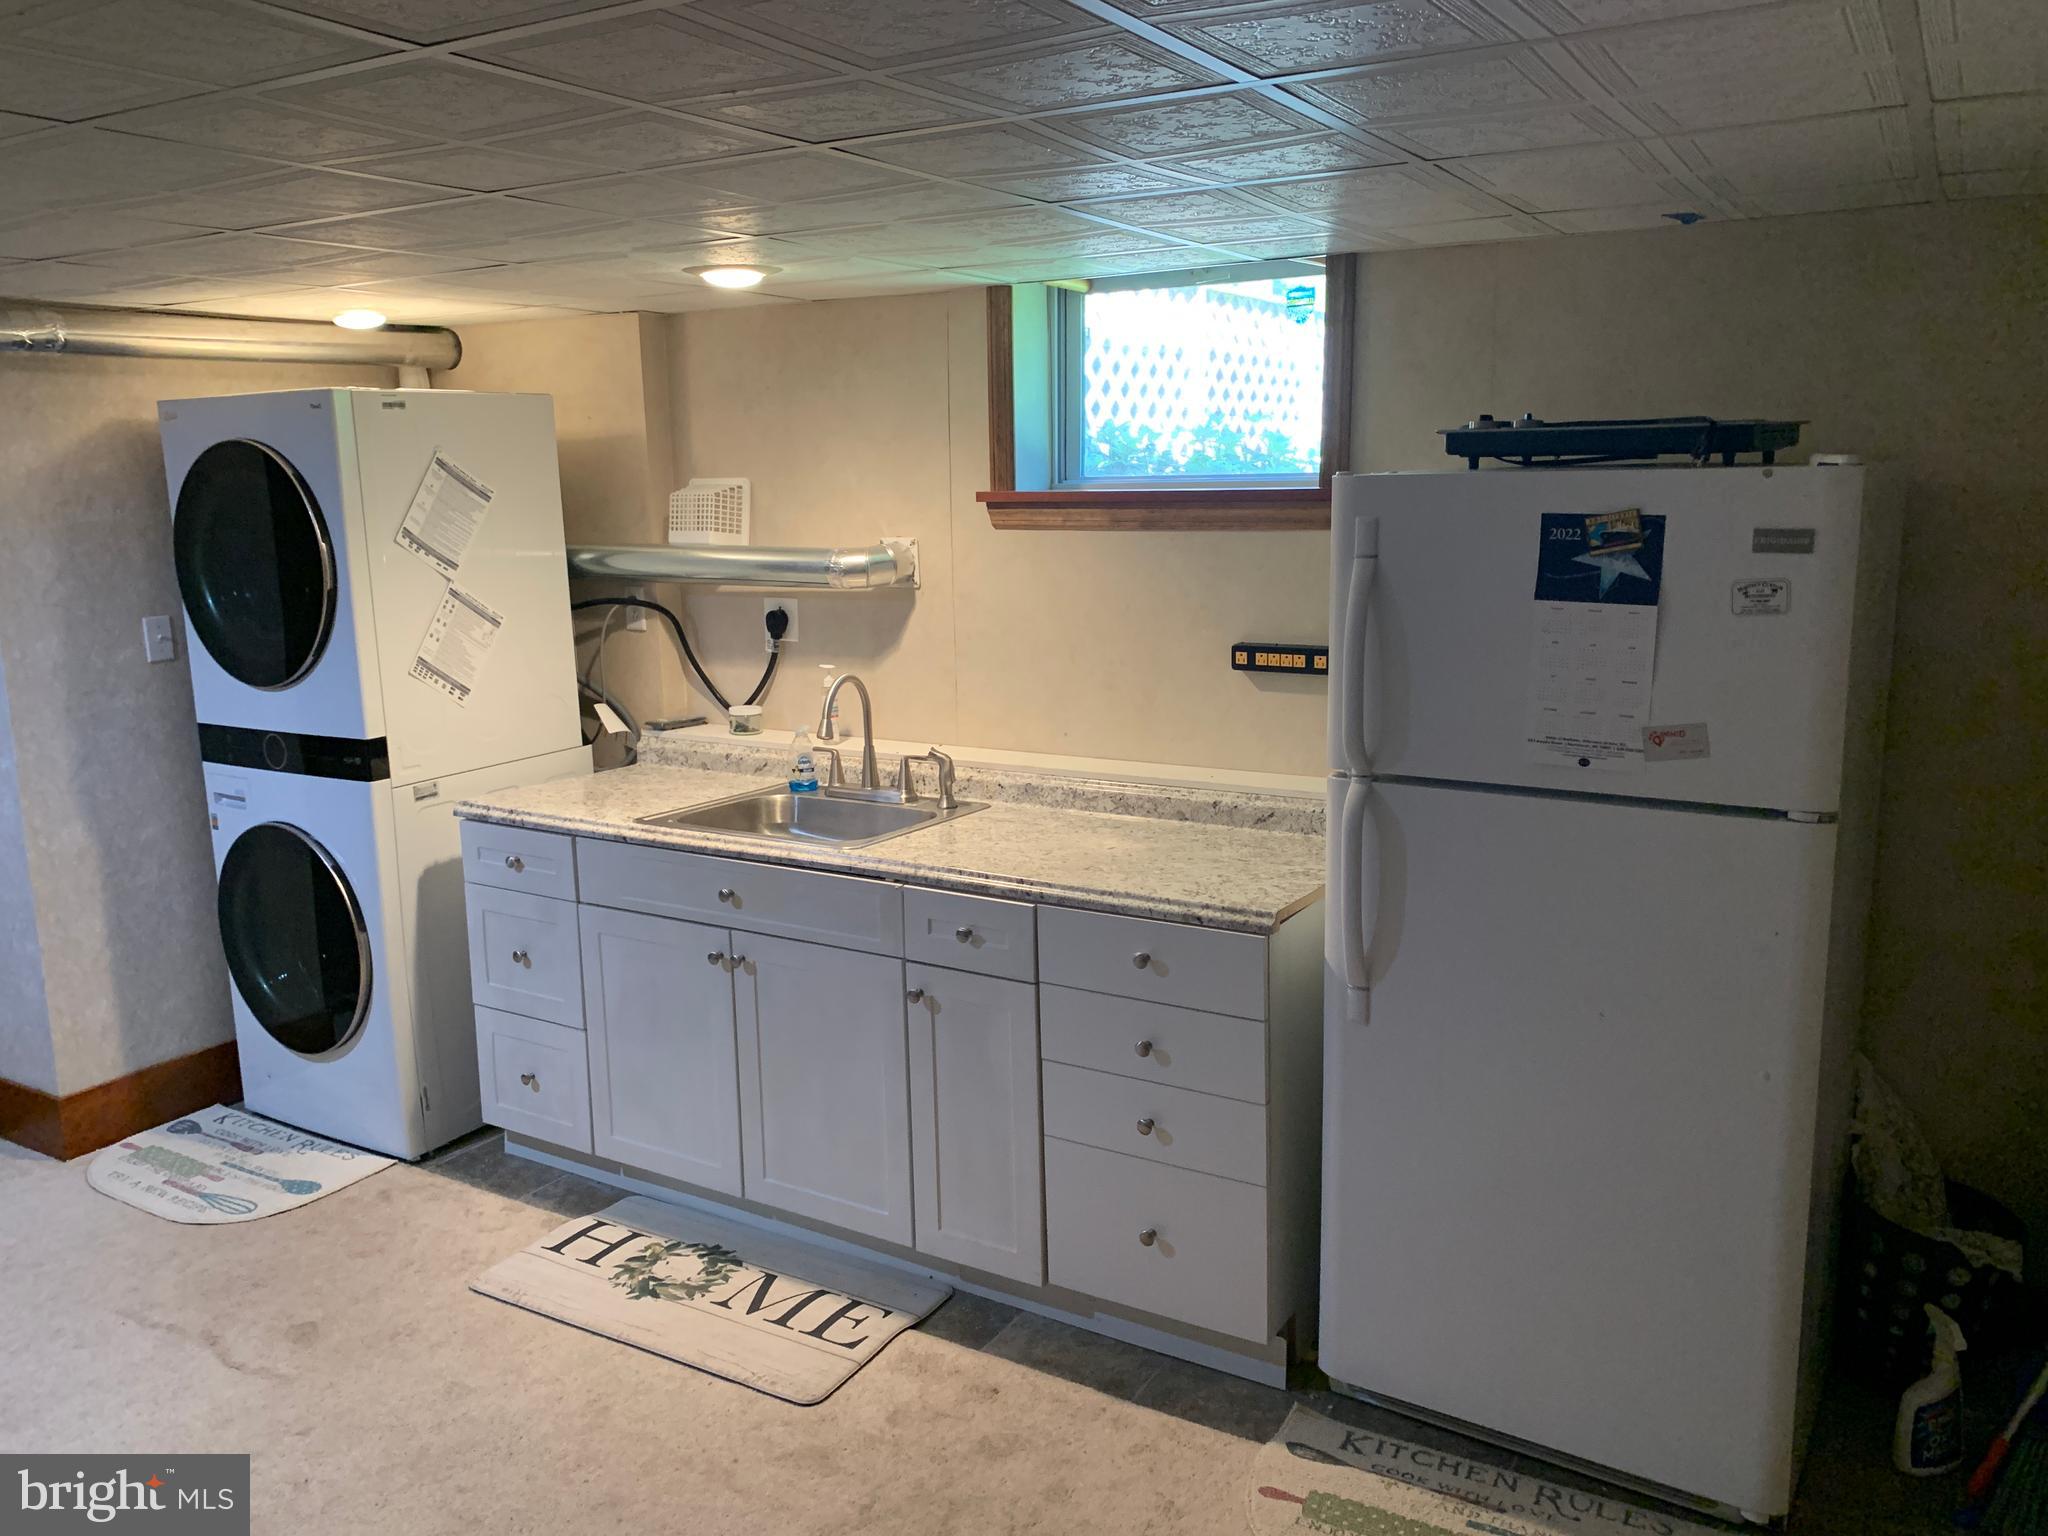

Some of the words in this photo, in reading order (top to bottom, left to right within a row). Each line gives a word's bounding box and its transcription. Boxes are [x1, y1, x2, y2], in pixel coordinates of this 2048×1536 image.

[1548, 527, 1582, 541] 2022
[213, 1111, 298, 1143] KITCHEN
[1338, 1429, 1522, 1493] KITCHEN
[1532, 1484, 1676, 1536] RULES
[1370, 1462, 1429, 1486] COOK
